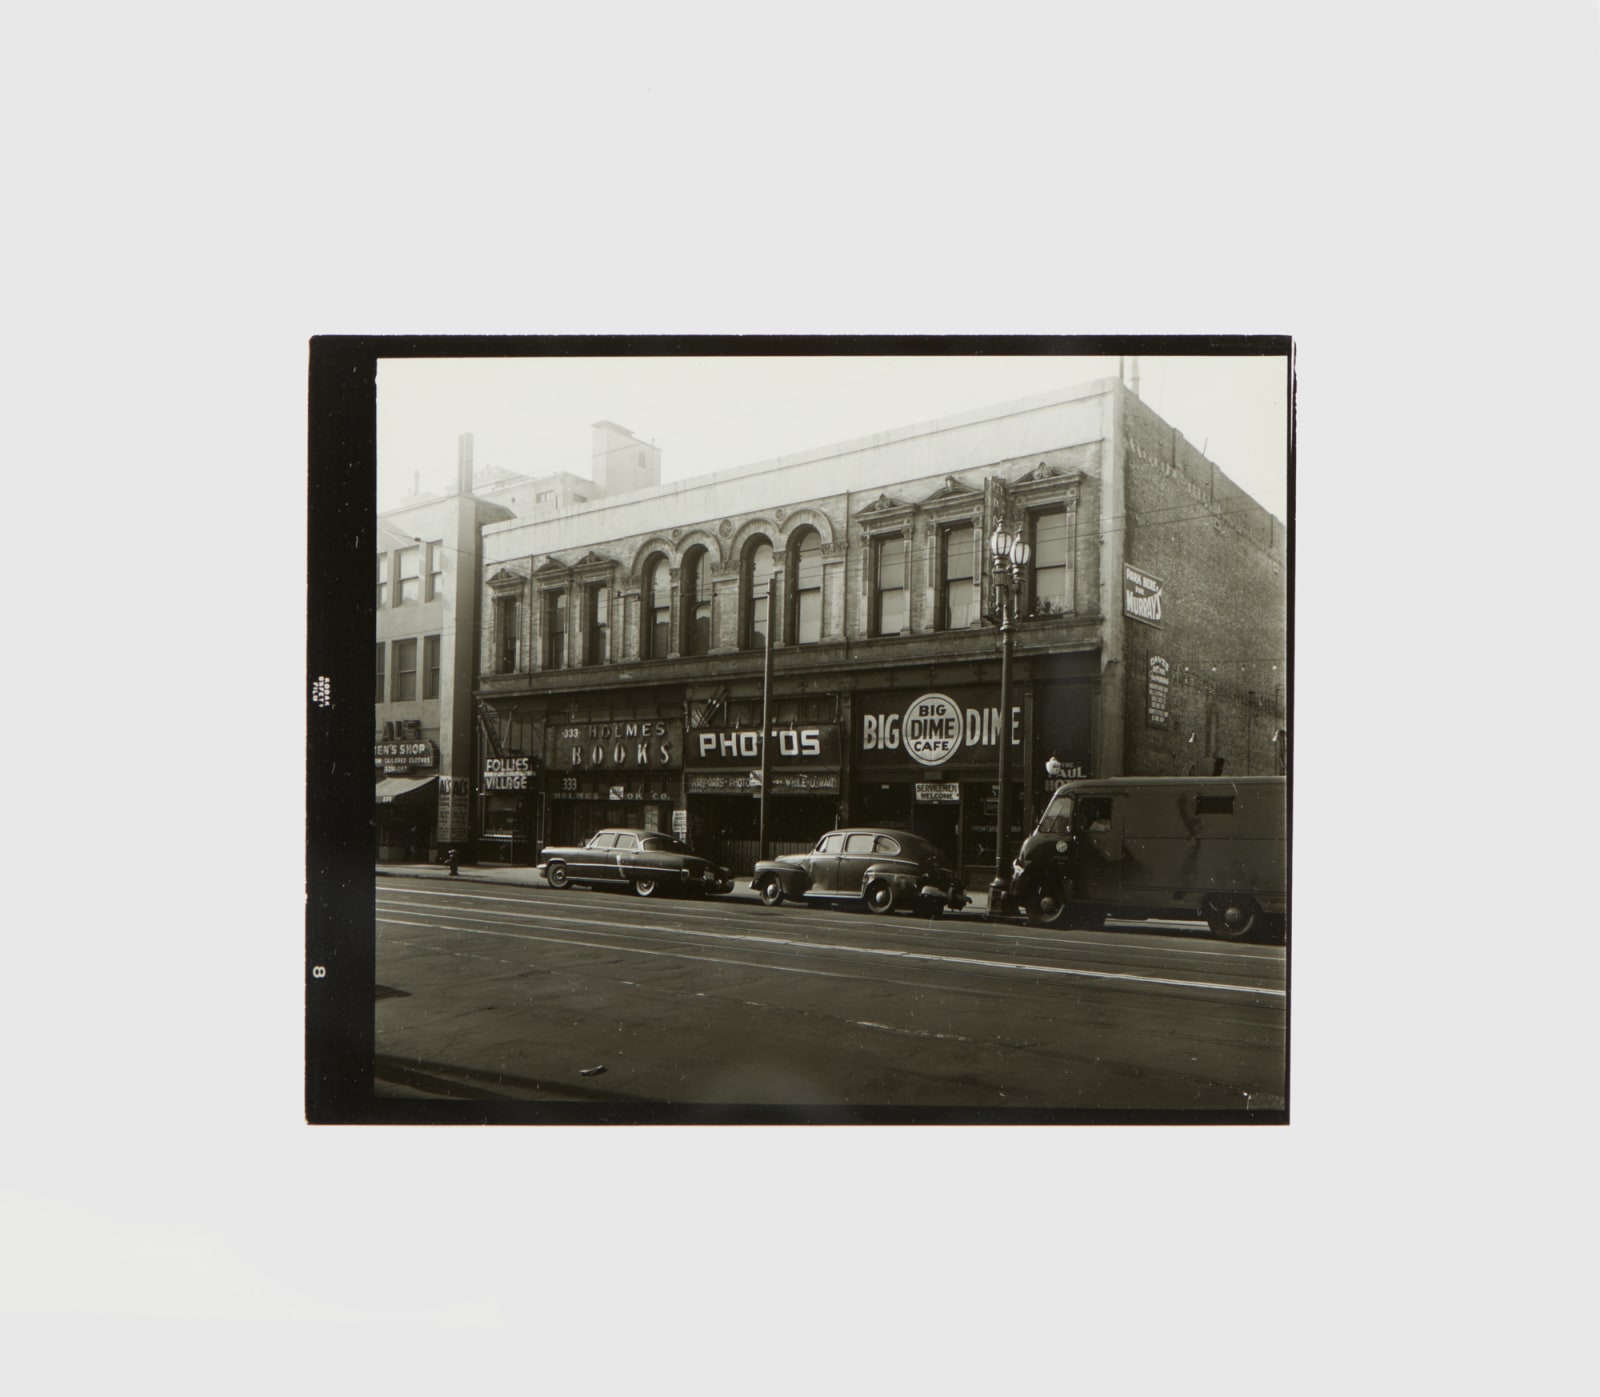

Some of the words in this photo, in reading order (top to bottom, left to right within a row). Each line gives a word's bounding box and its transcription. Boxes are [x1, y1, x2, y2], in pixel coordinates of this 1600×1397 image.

[323, 676, 331, 706] KODAK
[919, 704, 946, 717] BIG
[588, 721, 666, 740] HOLMES
[863, 713, 900, 750] BIG
[911, 718, 955, 741] DIME
[399, 743, 426, 755] SHOP
[913, 740, 949, 752] CAFE
[408, 756, 430, 764] CLOTHES
[572, 742, 670, 766] BOOKS
[486, 757, 529, 772] FOLLIES
[486, 776, 528, 790] VILLAGE
[562, 777, 577, 791] 333
[729, 777, 751, 788] PHOTO
[554, 791, 599, 800] HOLMES
[312, 965, 326, 979] 8
